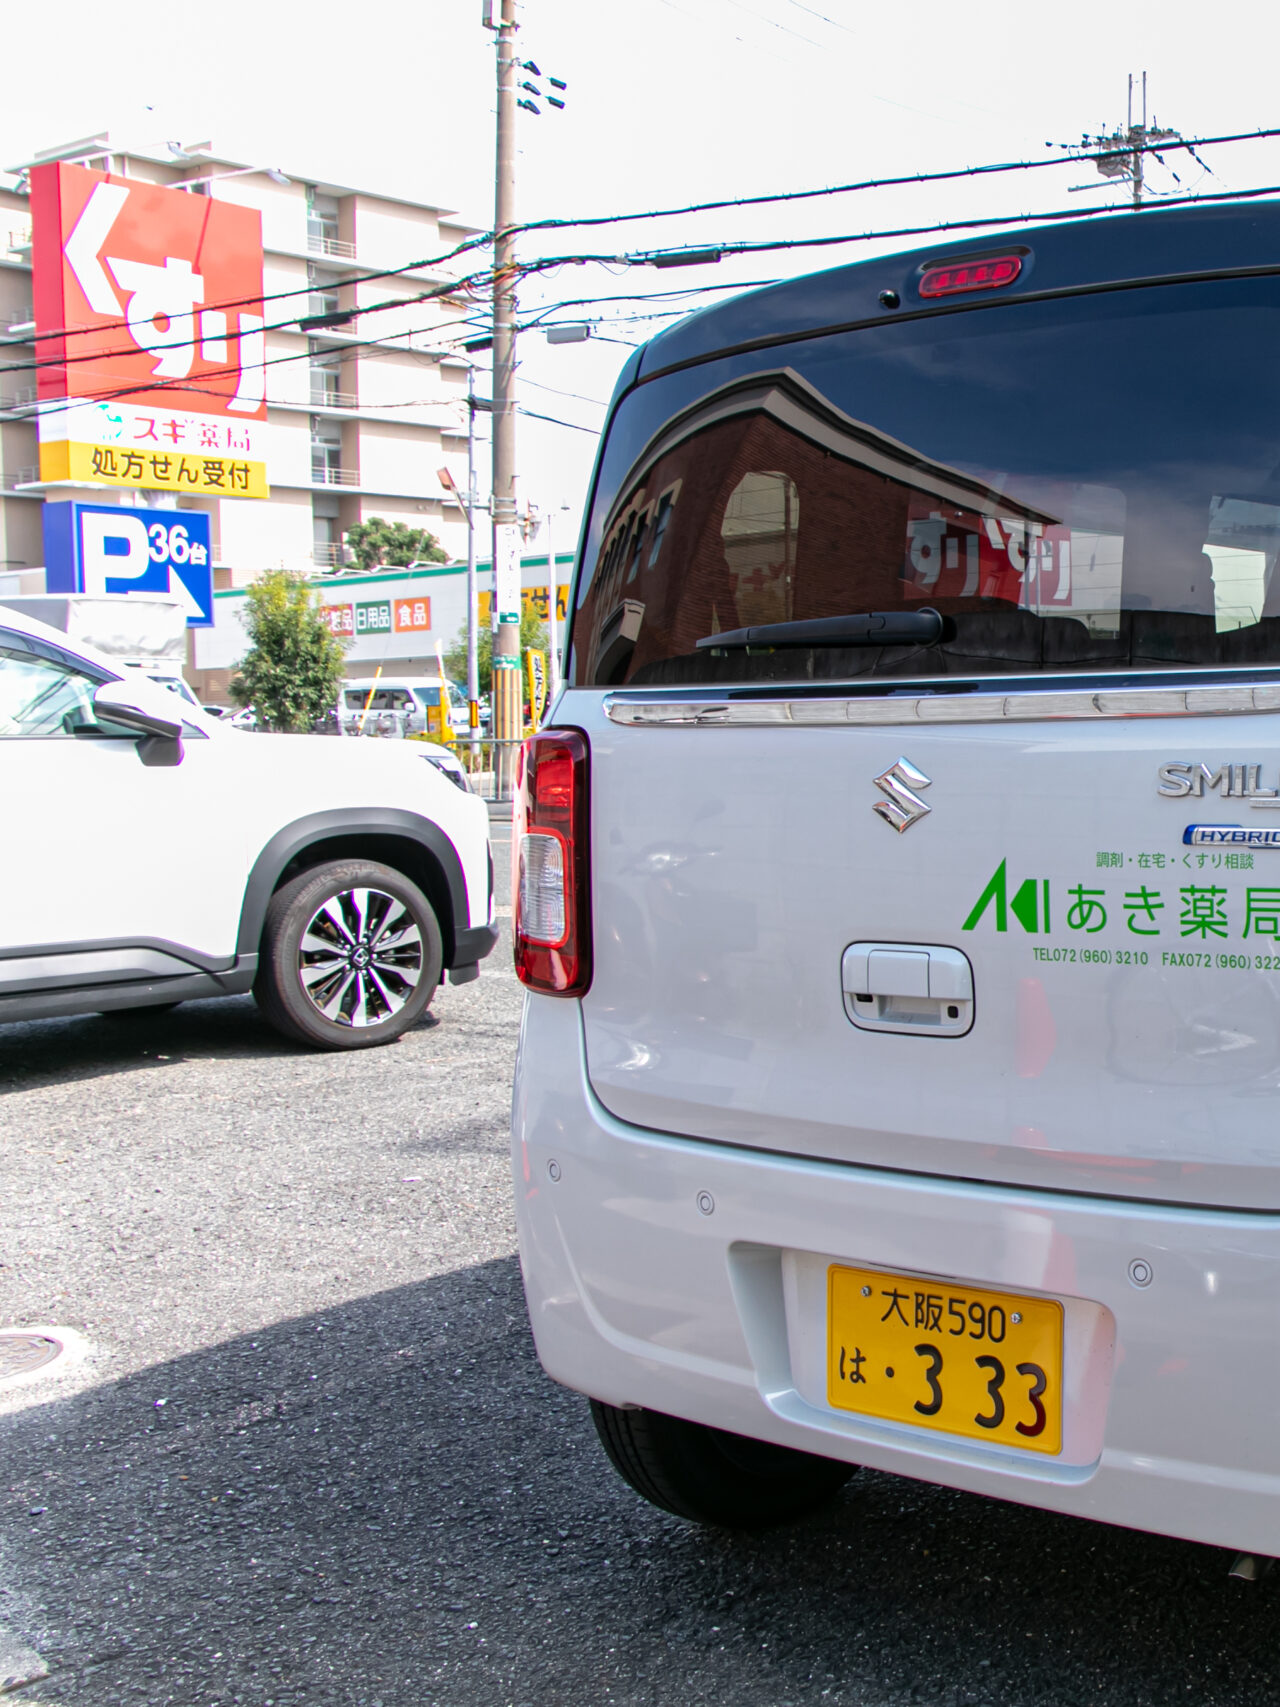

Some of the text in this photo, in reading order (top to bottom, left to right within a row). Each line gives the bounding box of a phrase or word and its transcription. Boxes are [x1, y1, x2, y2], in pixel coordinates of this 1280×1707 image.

[64, 181, 264, 413] くすり
[91, 447, 251, 491] 処方せん受付
[81, 511, 150, 594] P
[356, 605, 390, 630] 日用品
[397, 602, 427, 628] 食品
[1096, 852, 1255, 870] 調剤・在宅・くすり相談
